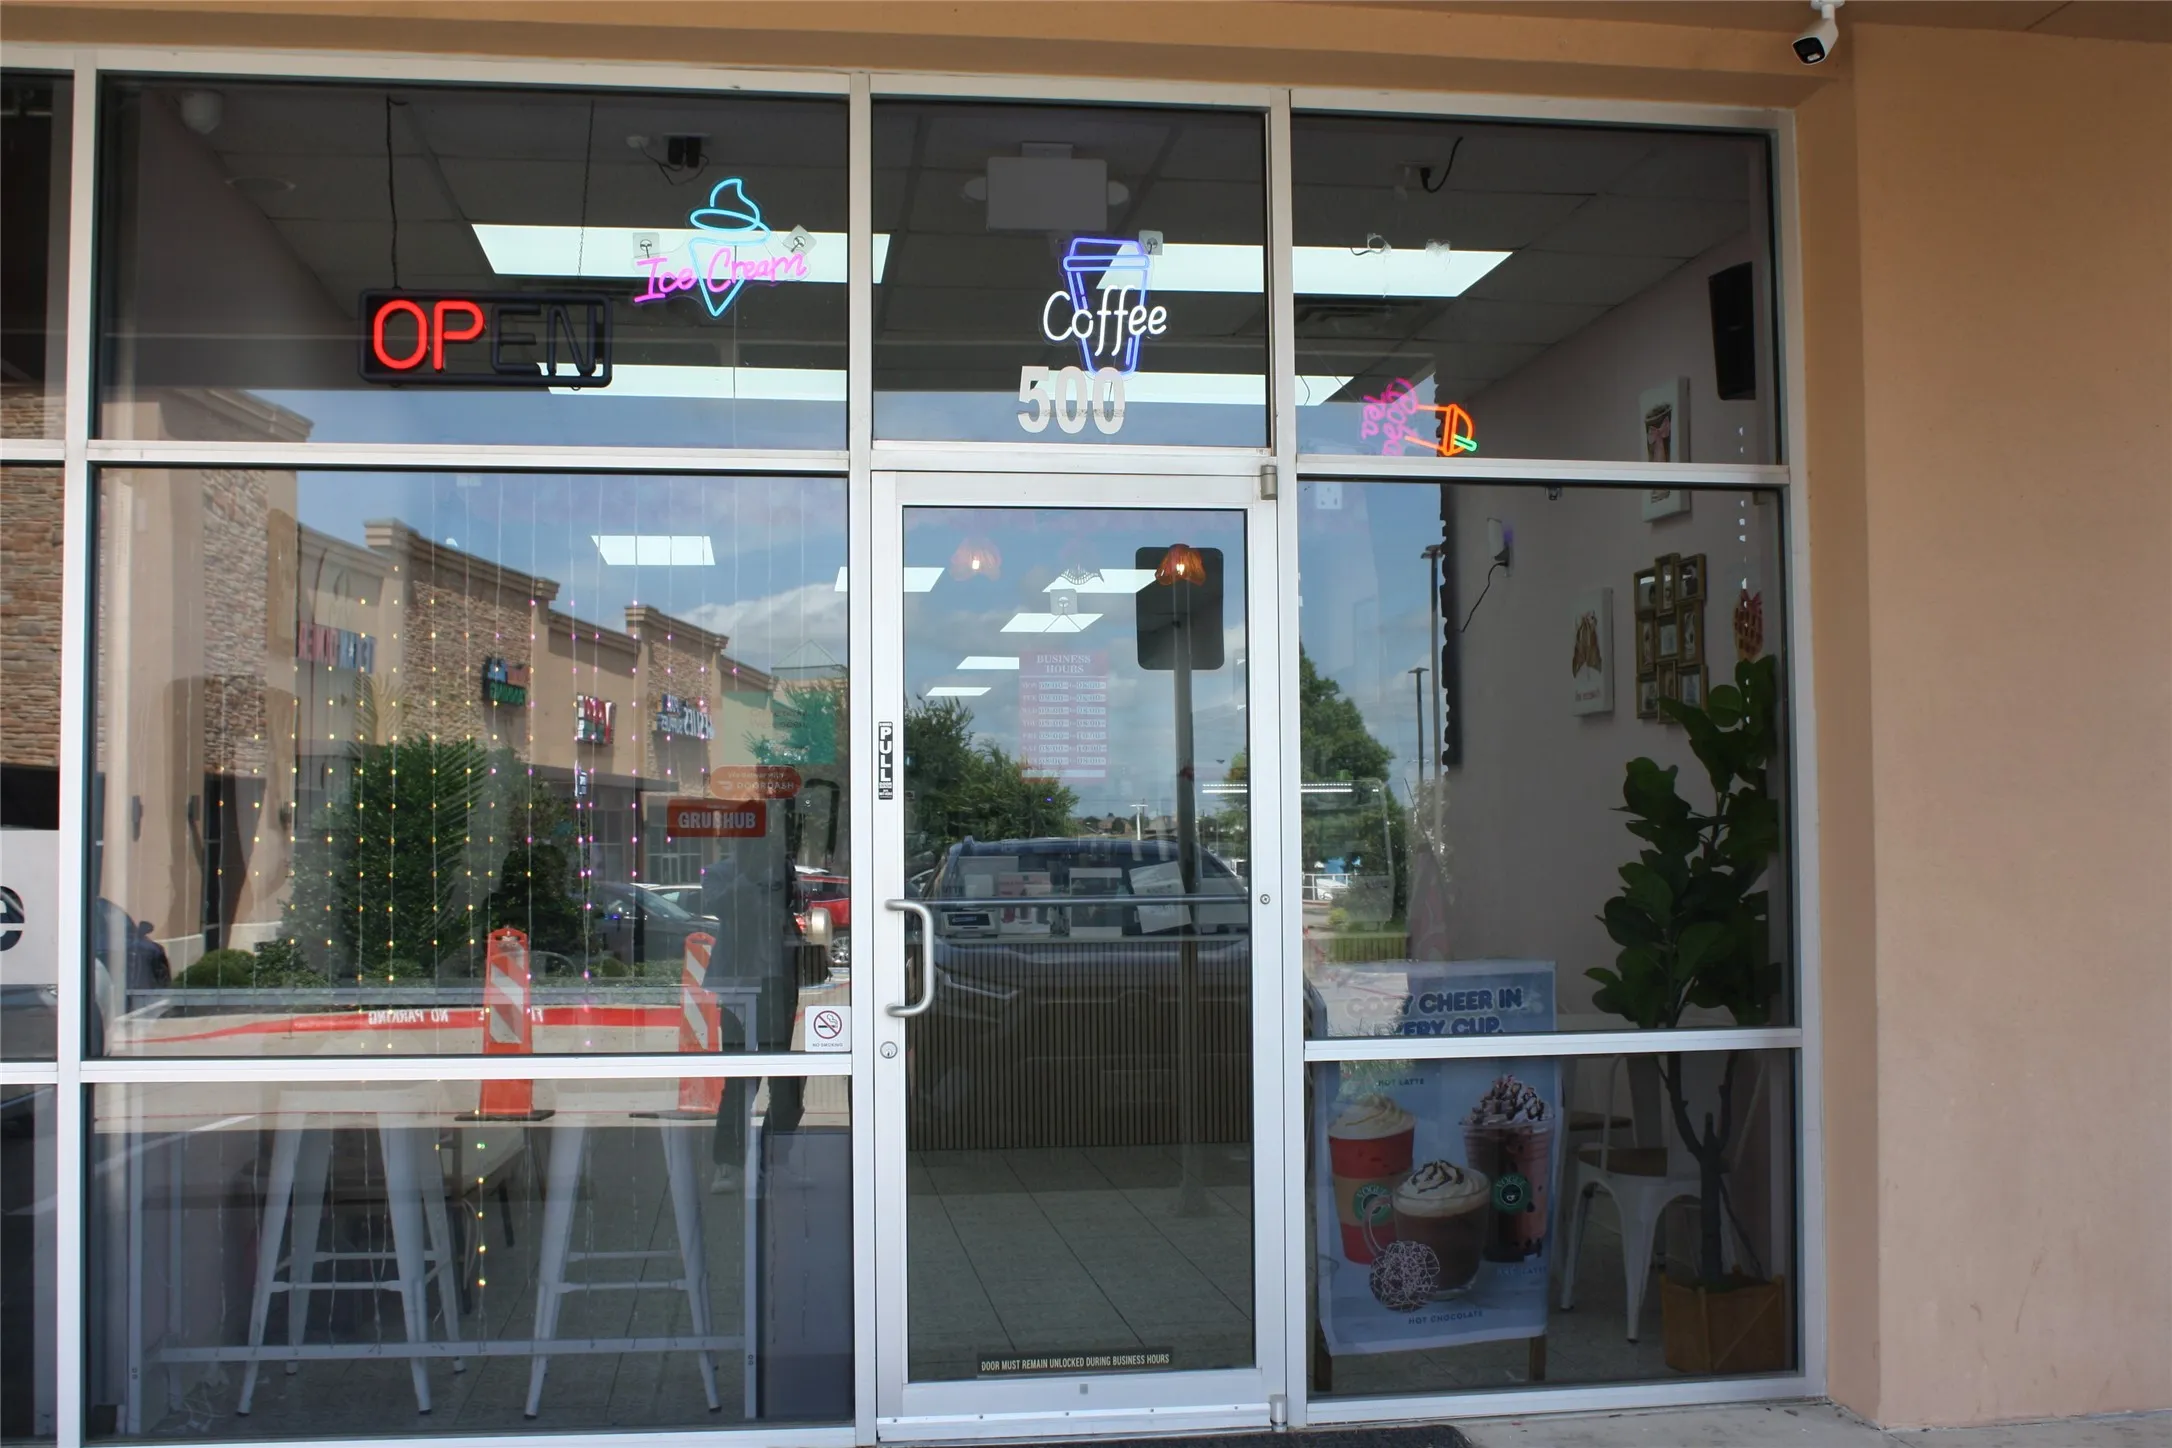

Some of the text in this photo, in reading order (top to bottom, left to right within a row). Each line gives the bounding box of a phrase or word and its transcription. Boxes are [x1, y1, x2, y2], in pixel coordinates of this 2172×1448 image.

[634, 247, 807, 302] Ice Cream
[1042, 284, 1168, 357] Coffee
[372, 299, 600, 378] OPEN
[1017, 365, 1126, 435] 500
[1036, 654, 1091, 664] BUSINESS
[1046, 664, 1084, 674] HOURS
[879, 726, 892, 782] PULL
[736, 781, 794, 790] DOORDASH
[677, 810, 757, 830] GRUBHUB
[1418, 989, 1493, 1014] CHEER
[1499, 987, 1523, 1009] IN
[1399, 1077, 1424, 1086] LATTE
[1408, 1310, 1483, 1325] HOT CHOCOLATE
[981, 1353, 1170, 1372] DOOR MUST REMAIN UNLOCKED DURING BUSINESS HOURS
